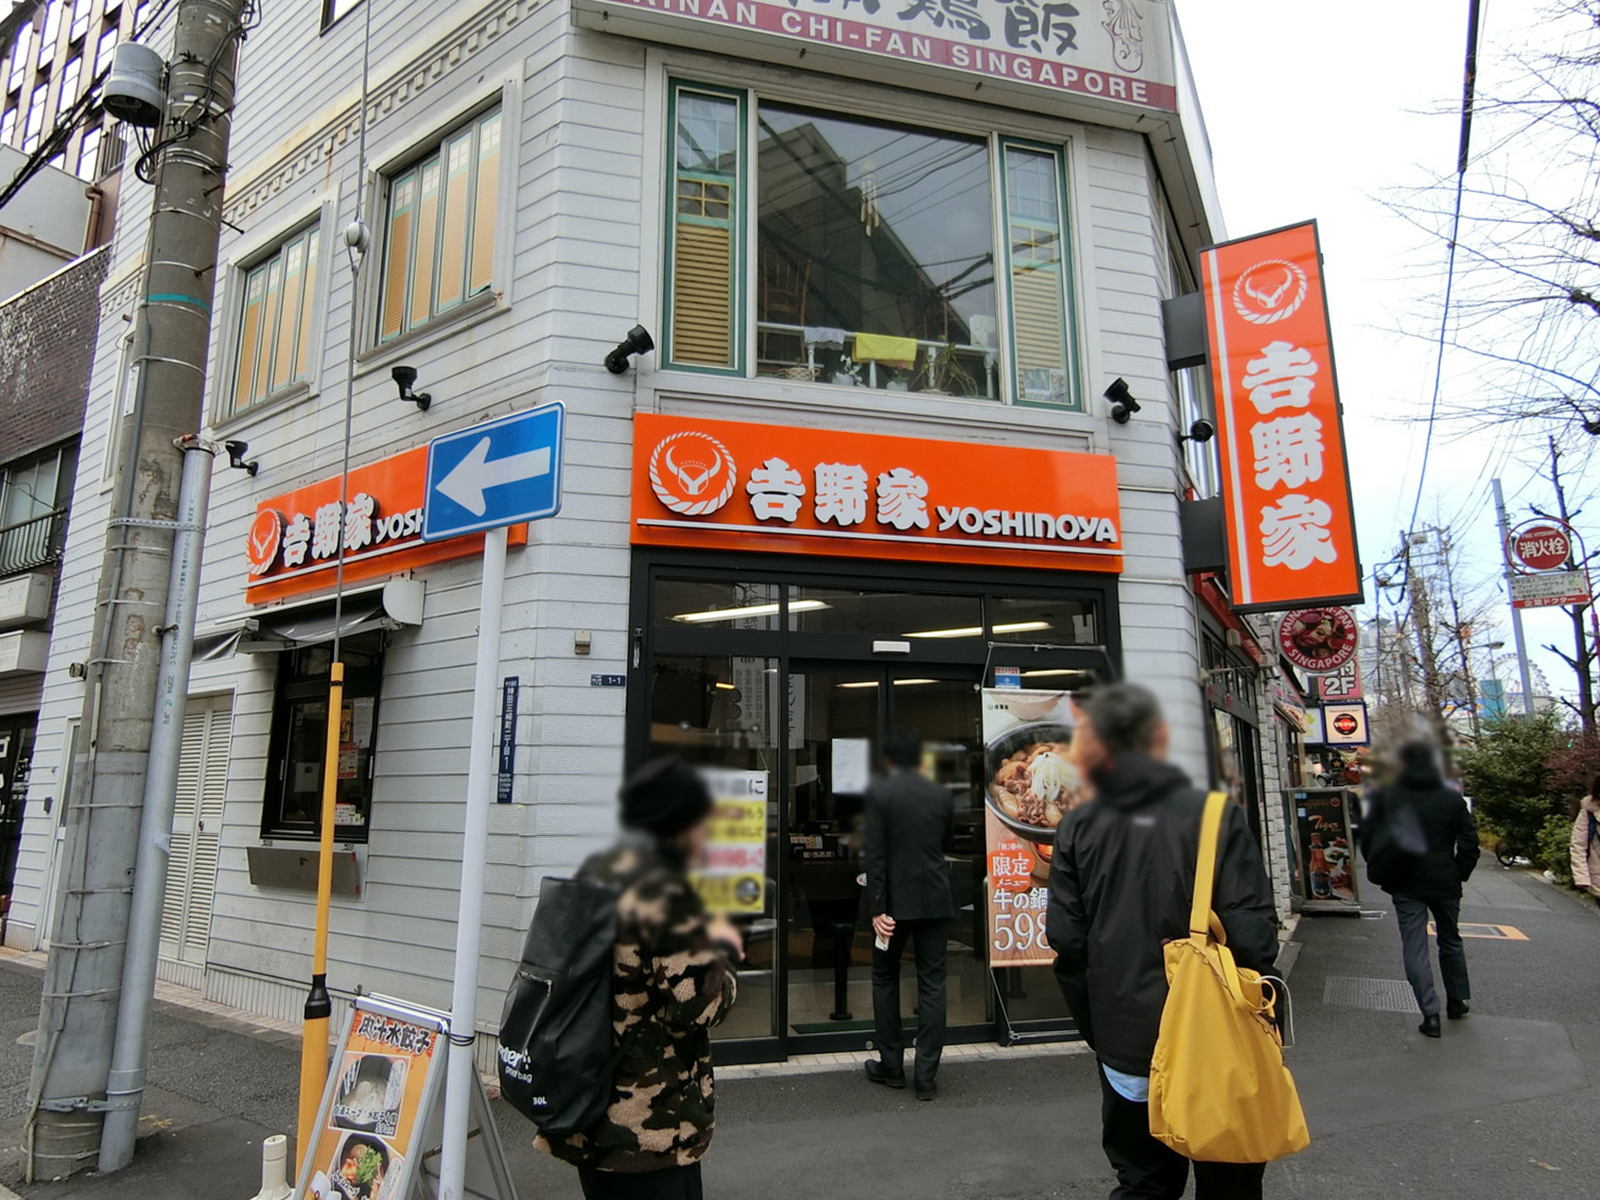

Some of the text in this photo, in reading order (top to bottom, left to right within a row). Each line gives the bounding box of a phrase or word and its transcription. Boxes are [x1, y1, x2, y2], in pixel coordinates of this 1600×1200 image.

[781, 11, 931, 60] CHI-FAN
[952, 45, 1149, 103] SINGAPORE
[1241, 341, 1337, 570] 吉野家
[746, 456, 930, 530] 吉野家
[283, 493, 377, 568] 吉野家
[937, 505, 1118, 543] YOSHINOYA
[1518, 537, 1566, 558] 消火栓
[1288, 643, 1352, 669] SINGAPORE
[1323, 676, 1356, 695] 2F
[992, 853, 1031, 877] 限定
[996, 878, 1028, 888] メニュー
[532, 1096, 547, 1106] 30L
